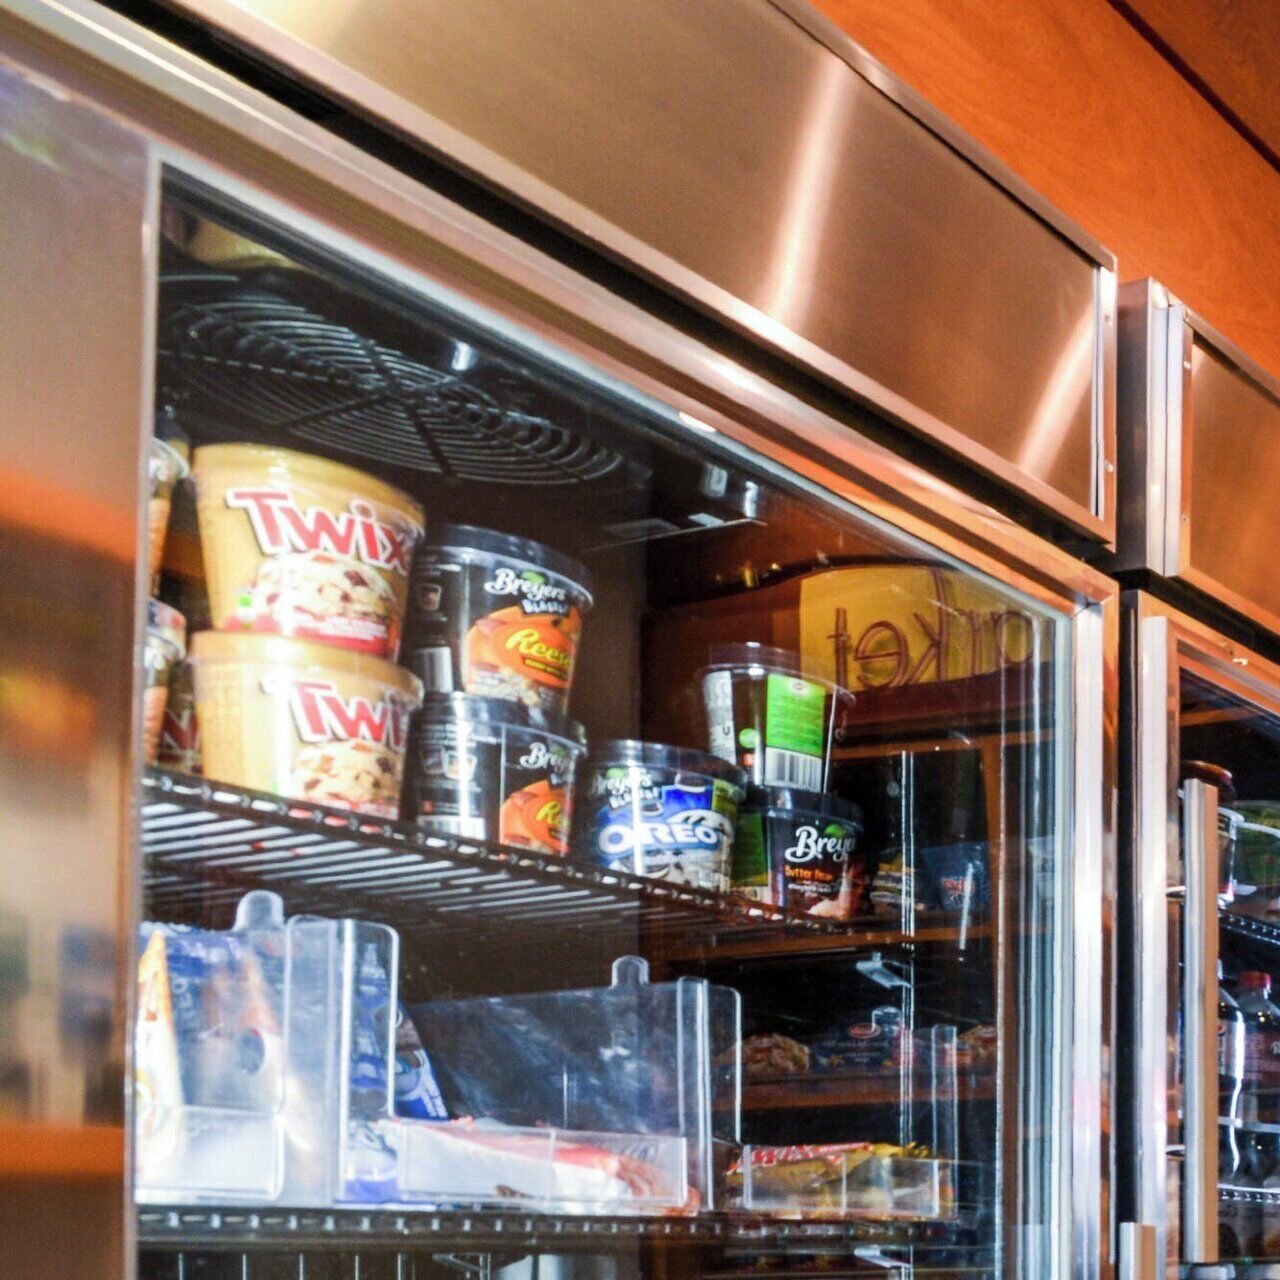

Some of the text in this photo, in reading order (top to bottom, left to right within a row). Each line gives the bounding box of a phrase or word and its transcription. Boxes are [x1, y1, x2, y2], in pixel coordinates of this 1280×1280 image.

[227, 487, 412, 572] Twix
[484, 568, 566, 601] Breyers
[599, 822, 719, 854] OREO
